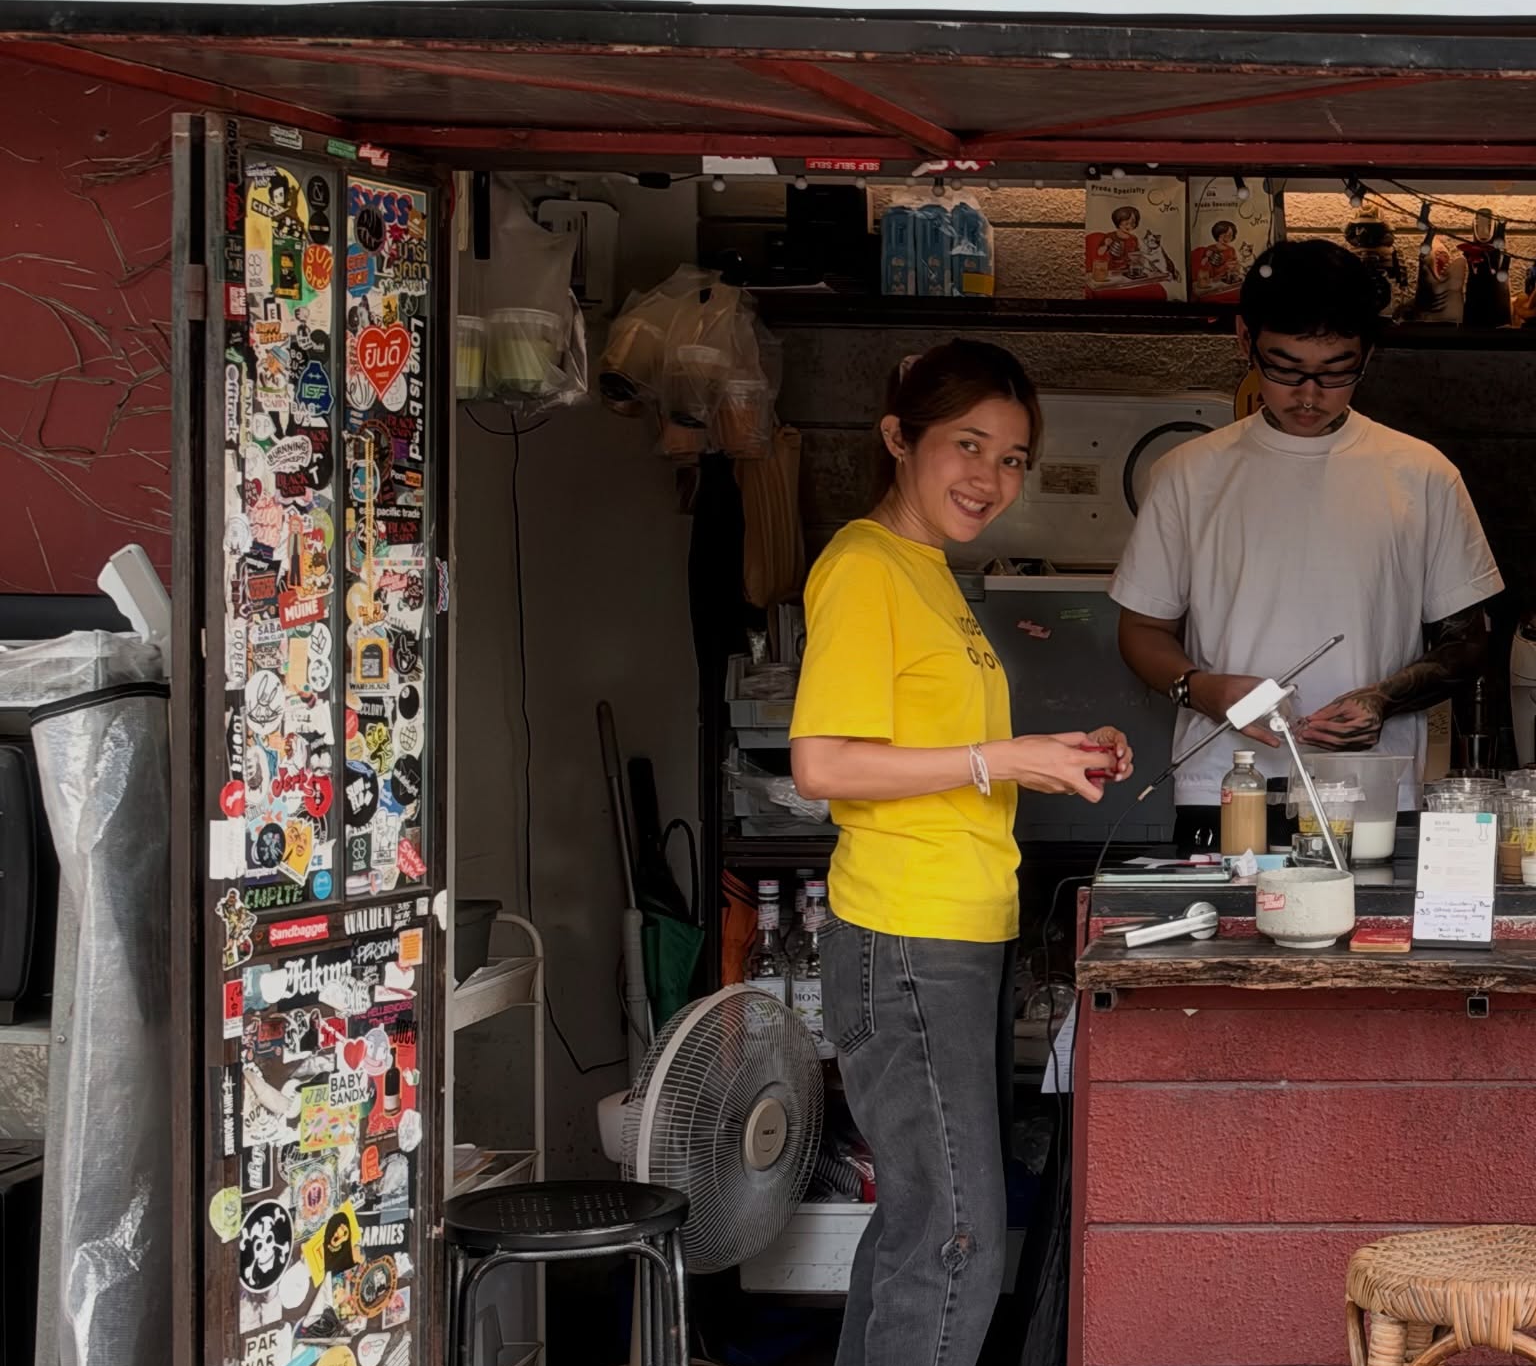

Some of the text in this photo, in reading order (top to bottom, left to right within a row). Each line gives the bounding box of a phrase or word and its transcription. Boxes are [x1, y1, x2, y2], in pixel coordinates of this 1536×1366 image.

[809, 160, 881, 172] SELF SELF SELF
[364, 337, 402, 369] ยินดี
[409, 317, 424, 375] Love
[409, 378, 424, 398] is
[376, 506, 401, 517] pacific
[403, 508, 421, 518] trade
[269, 922, 329, 941] Sandbagger
[344, 907, 393, 936] WALDEN
[794, 992, 821, 1002] MON
[330, 1072, 364, 1093] BABY
